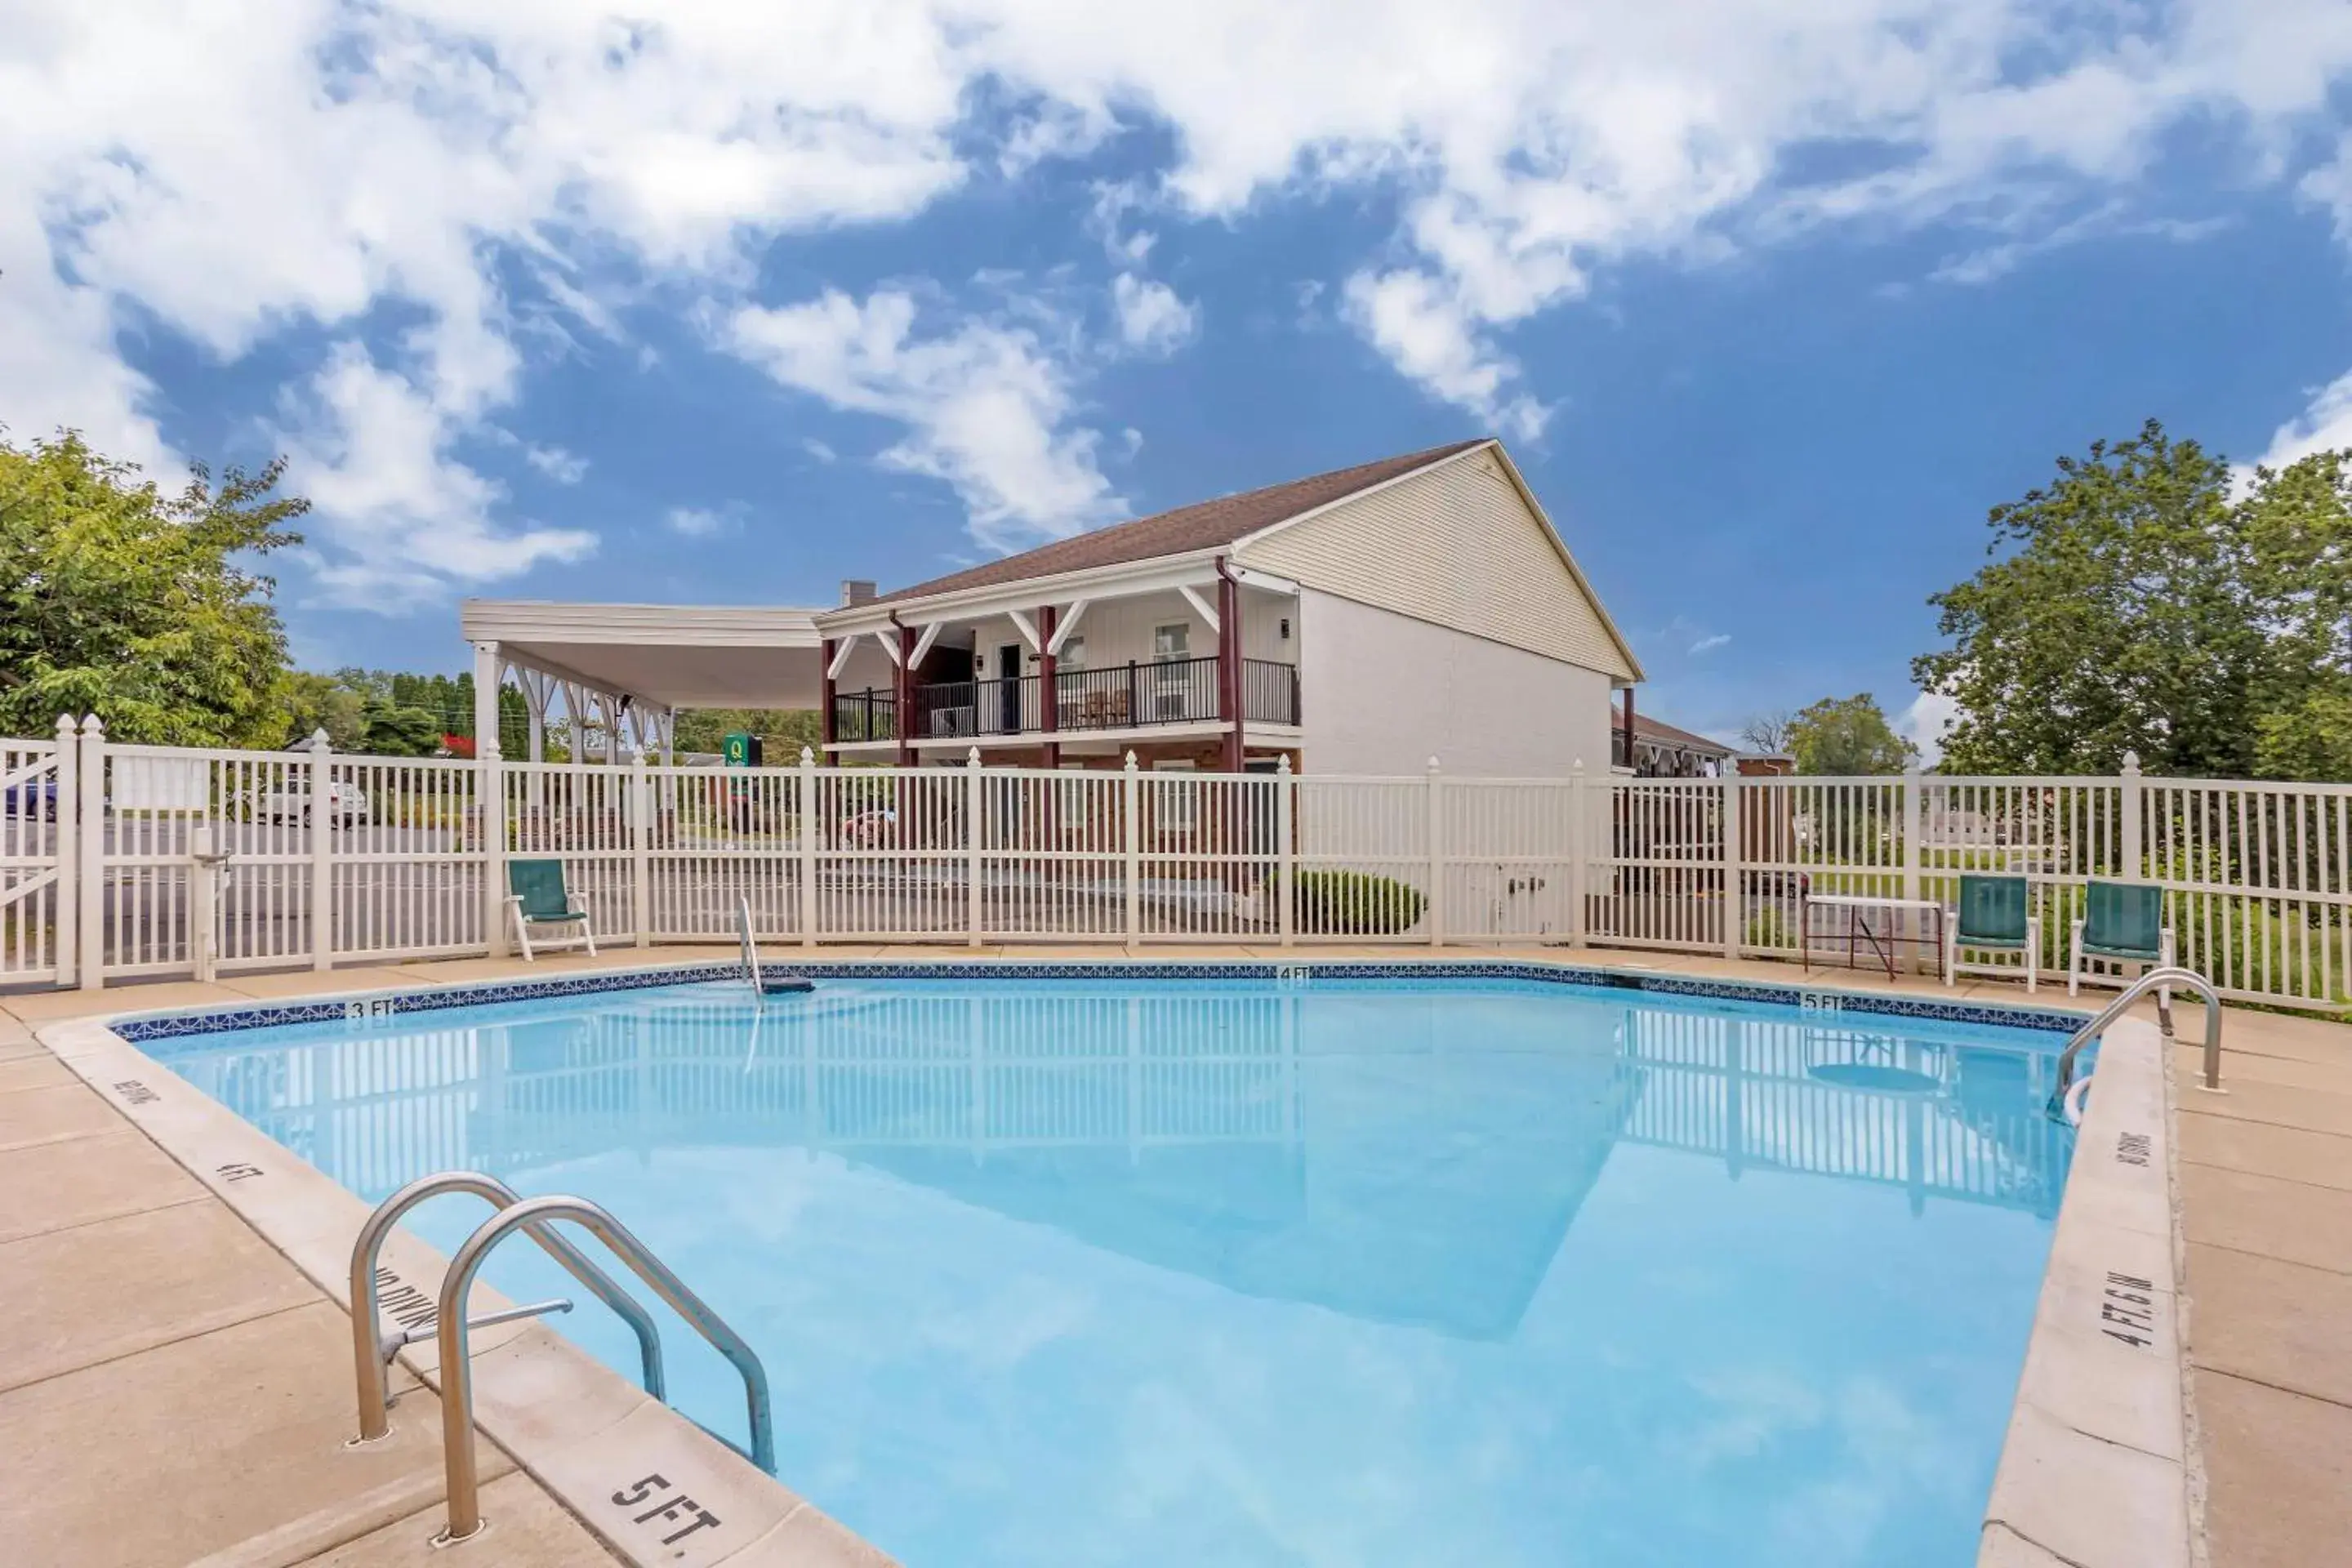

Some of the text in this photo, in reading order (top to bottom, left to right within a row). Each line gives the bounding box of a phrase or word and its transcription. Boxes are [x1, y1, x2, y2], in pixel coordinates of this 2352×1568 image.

[731, 741, 742, 759] Q
[1281, 967, 1308, 978] 4 FT
[351, 1000, 392, 1018] 3 FT
[1805, 994, 1839, 1010] 5 FT
[612, 1473, 721, 1558] 5 FT.
